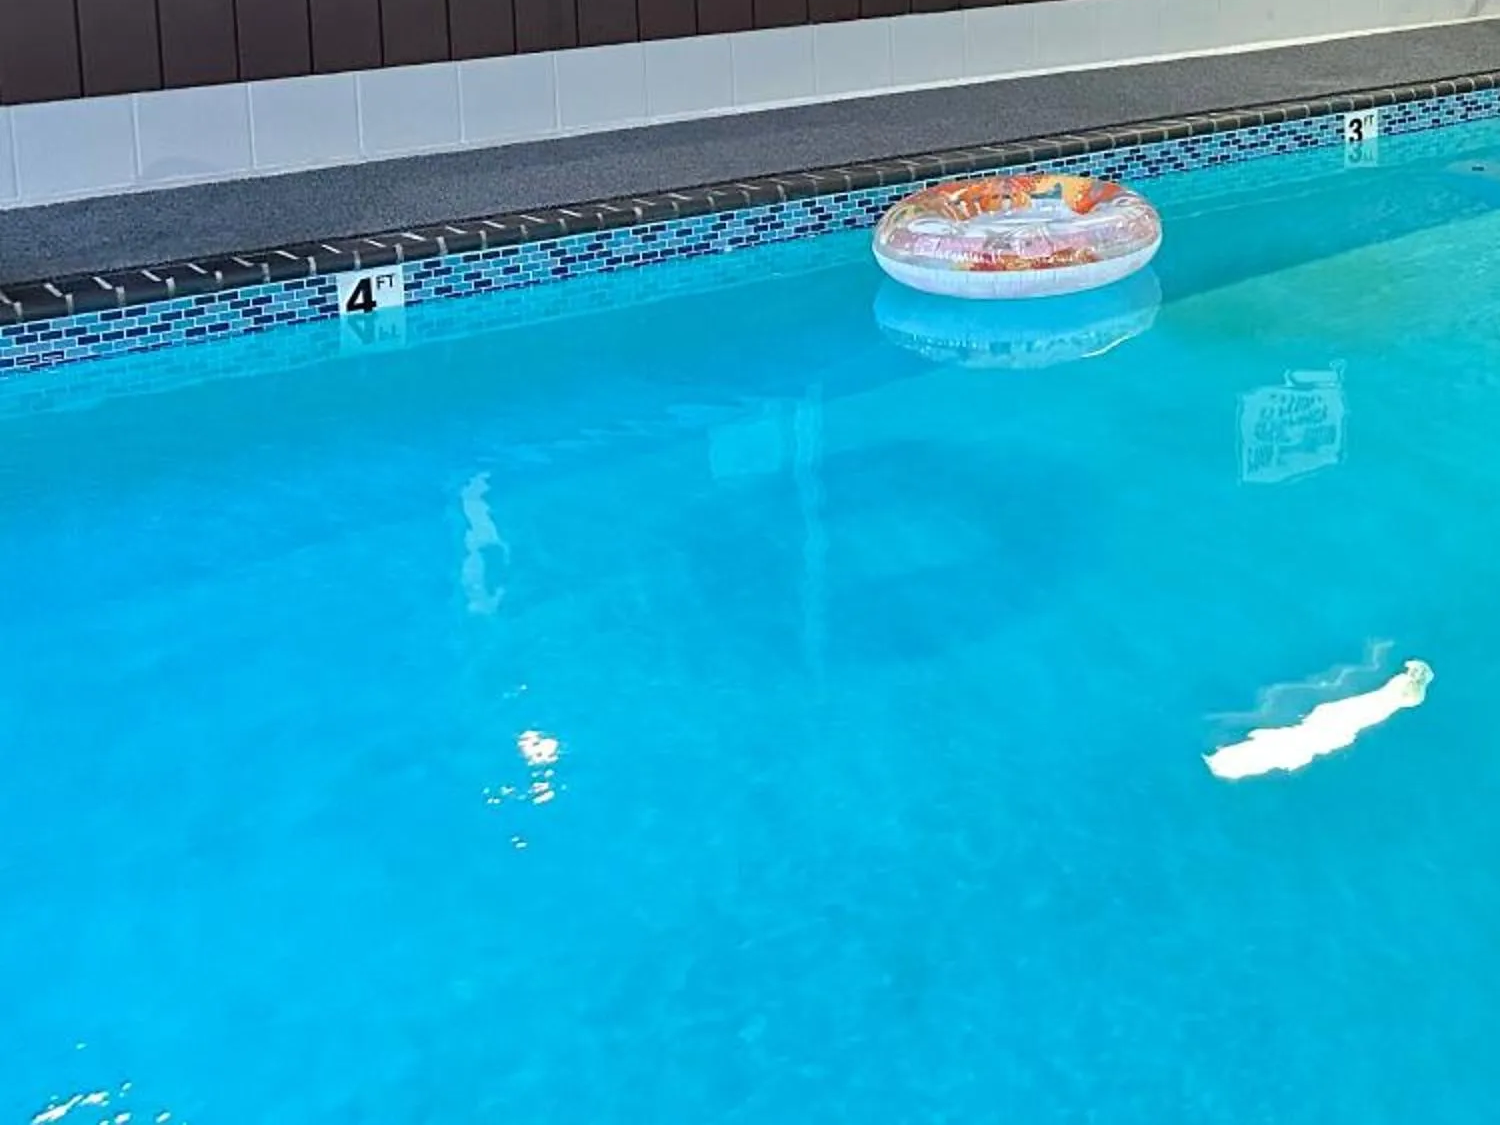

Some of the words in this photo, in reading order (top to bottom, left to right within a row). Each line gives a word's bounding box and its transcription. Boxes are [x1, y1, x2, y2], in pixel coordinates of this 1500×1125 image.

[1349, 118, 1363, 142] 3
[346, 277, 377, 313] 4
[376, 274, 394, 289] FT
